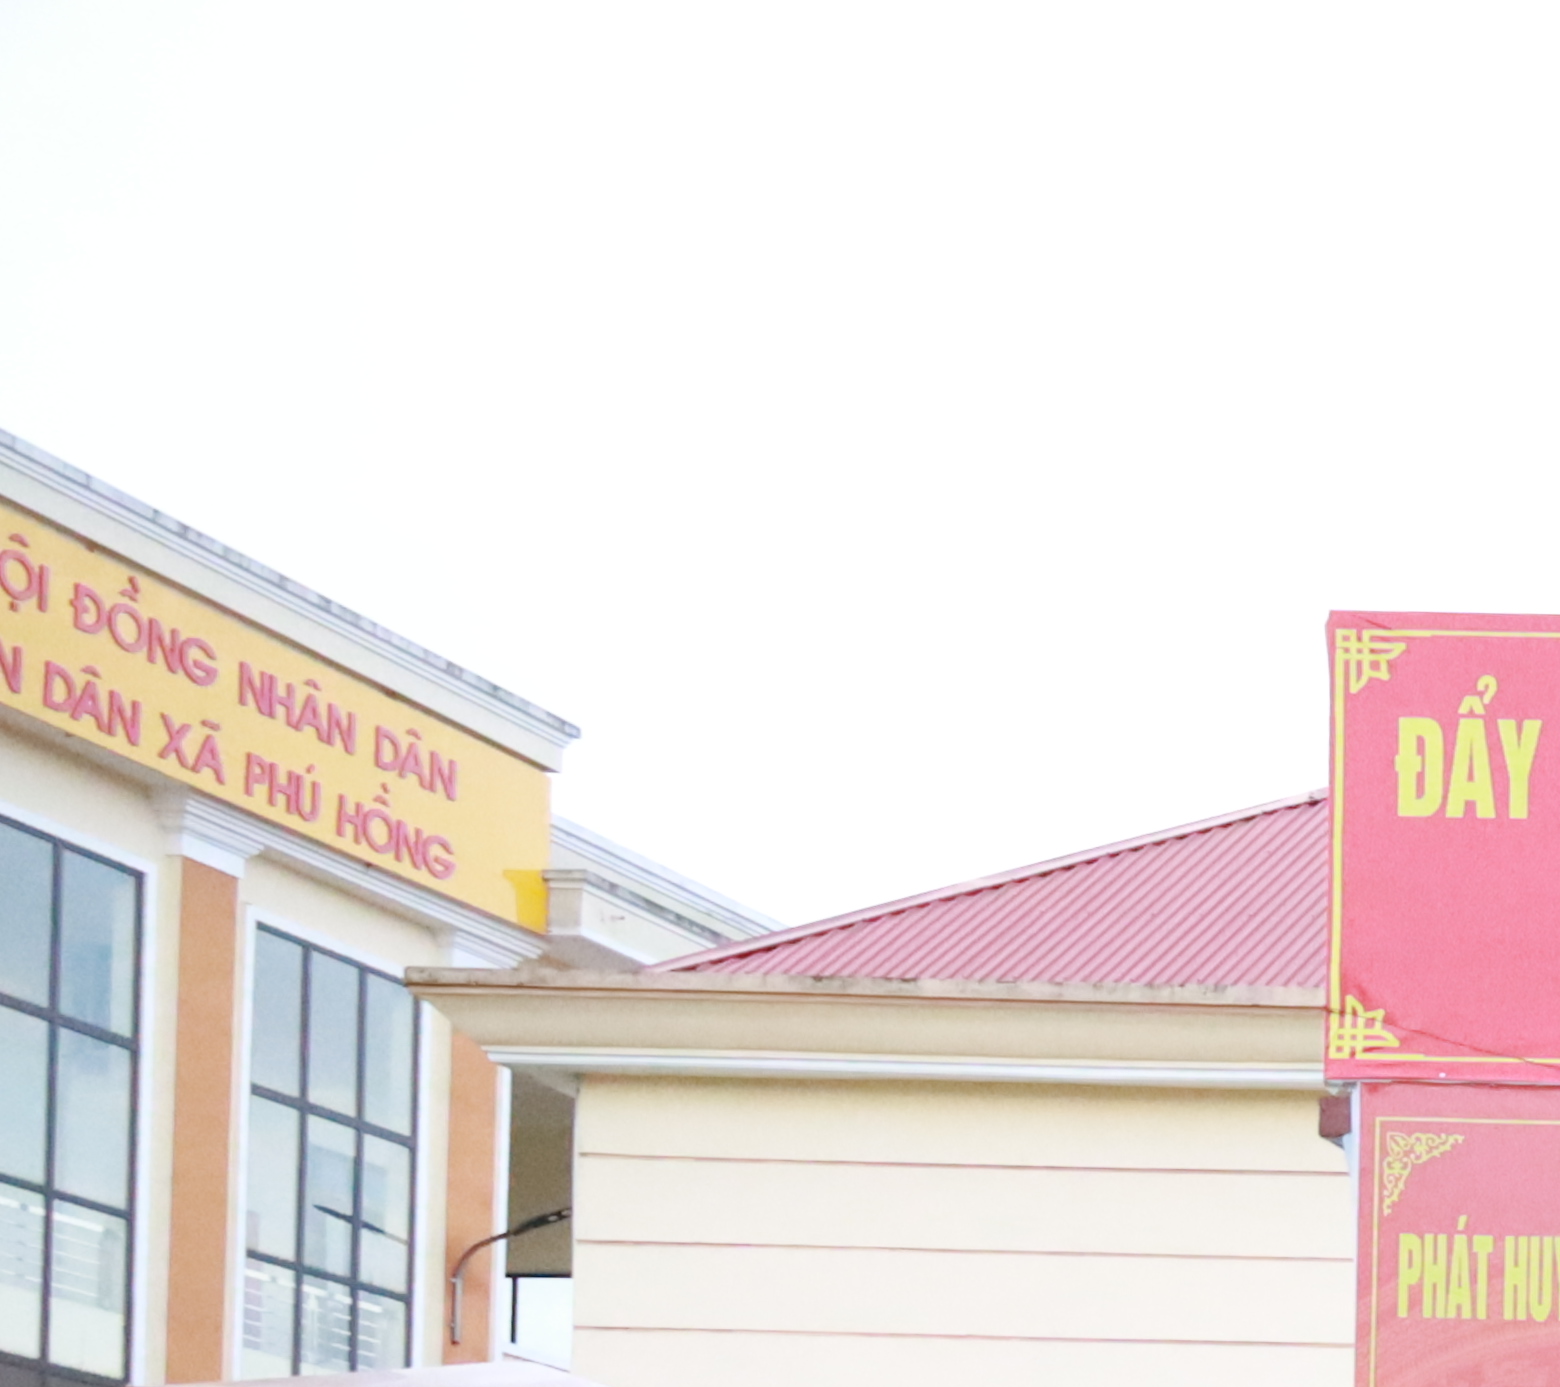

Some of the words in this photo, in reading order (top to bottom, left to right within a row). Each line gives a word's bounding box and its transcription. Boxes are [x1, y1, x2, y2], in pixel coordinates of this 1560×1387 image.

[0, 533, 49, 613] ỘI
[69, 575, 218, 686] ĐỒNG
[237, 660, 356, 755] NHÂN
[373, 725, 457, 801] DÂN
[1396, 676, 1541, 818] ĐẨY
[43, 660, 141, 746] DÂN
[158, 713, 224, 784] XÃ
[243, 752, 321, 822] PHÚ
[336, 783, 456, 879] HỒNG
[1399, 1217, 1494, 1318] PHÁT
